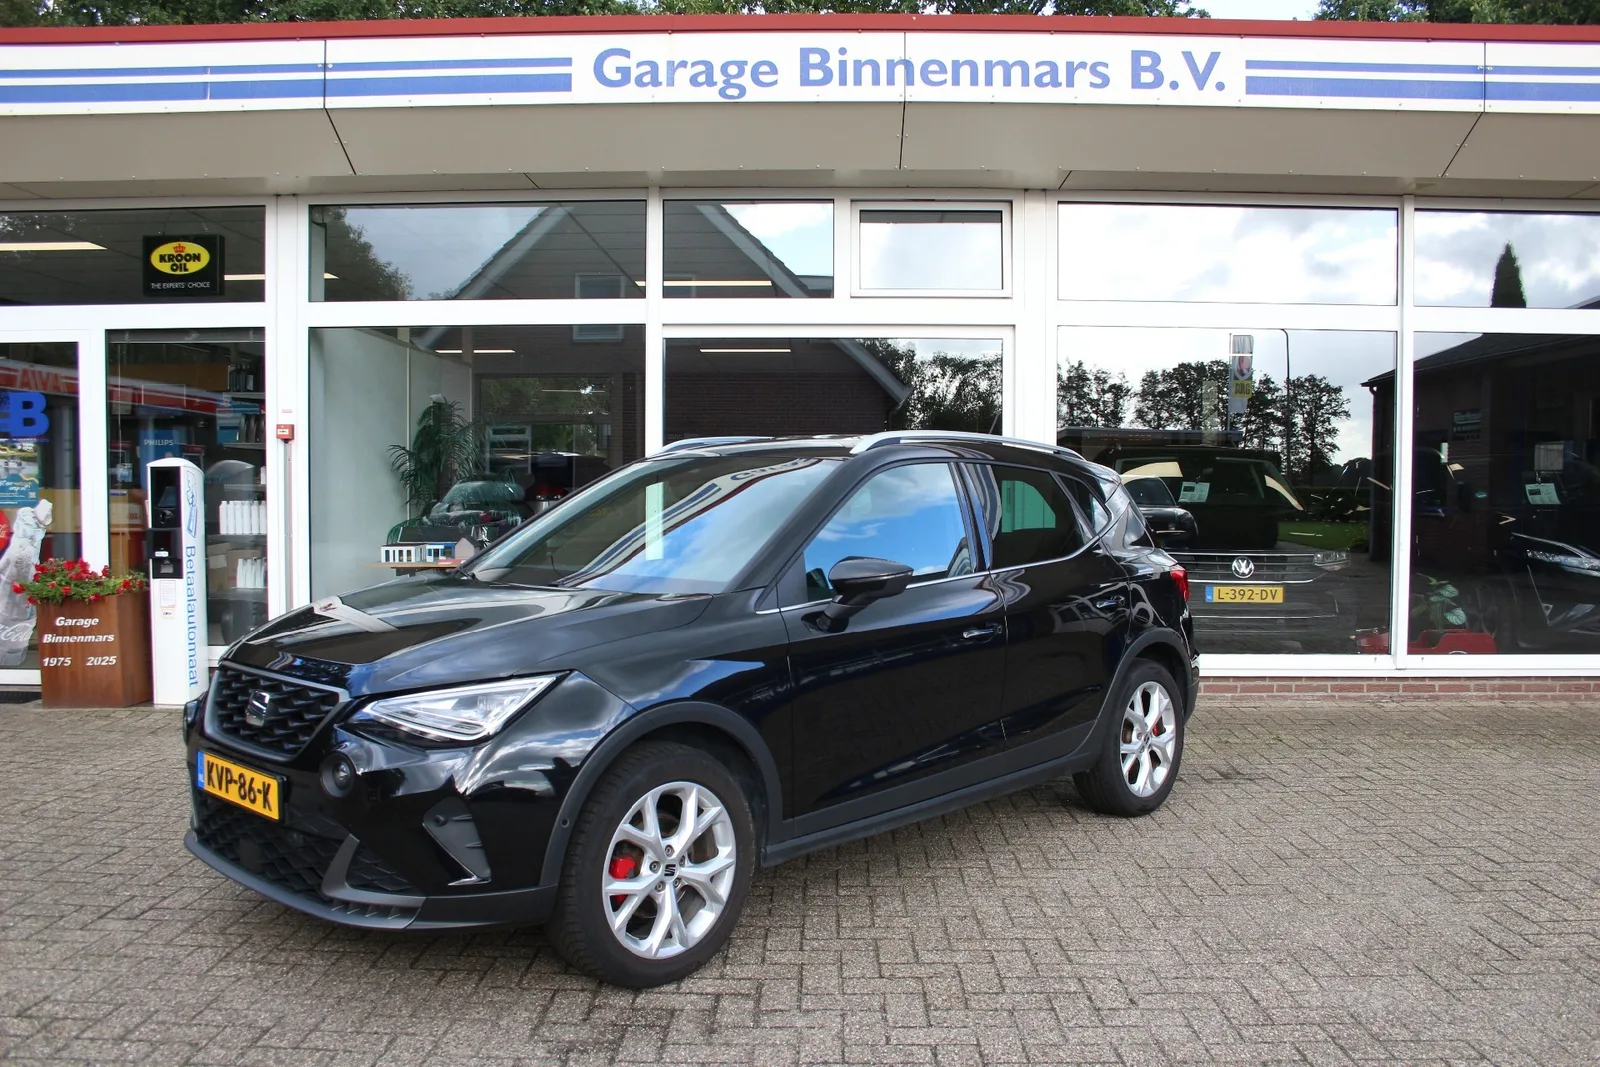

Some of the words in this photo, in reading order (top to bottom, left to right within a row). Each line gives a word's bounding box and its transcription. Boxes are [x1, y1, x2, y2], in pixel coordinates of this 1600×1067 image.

[593, 47, 779, 100] Garage
[799, 47, 1110, 89] Binnenmars
[1131, 49, 1225, 91] B.V.
[159, 253, 201, 263] KROON
[170, 263, 189, 272] OIL
[1217, 588, 1278, 601] L-392-DV
[55, 616, 99, 628] Garage
[185, 545, 199, 687] Betaalautomaat
[42, 633, 115, 644] Binnenmars
[43, 657, 72, 667] 1975
[86, 655, 117, 666] 2025
[206, 760, 273, 812] KVP-86-K
